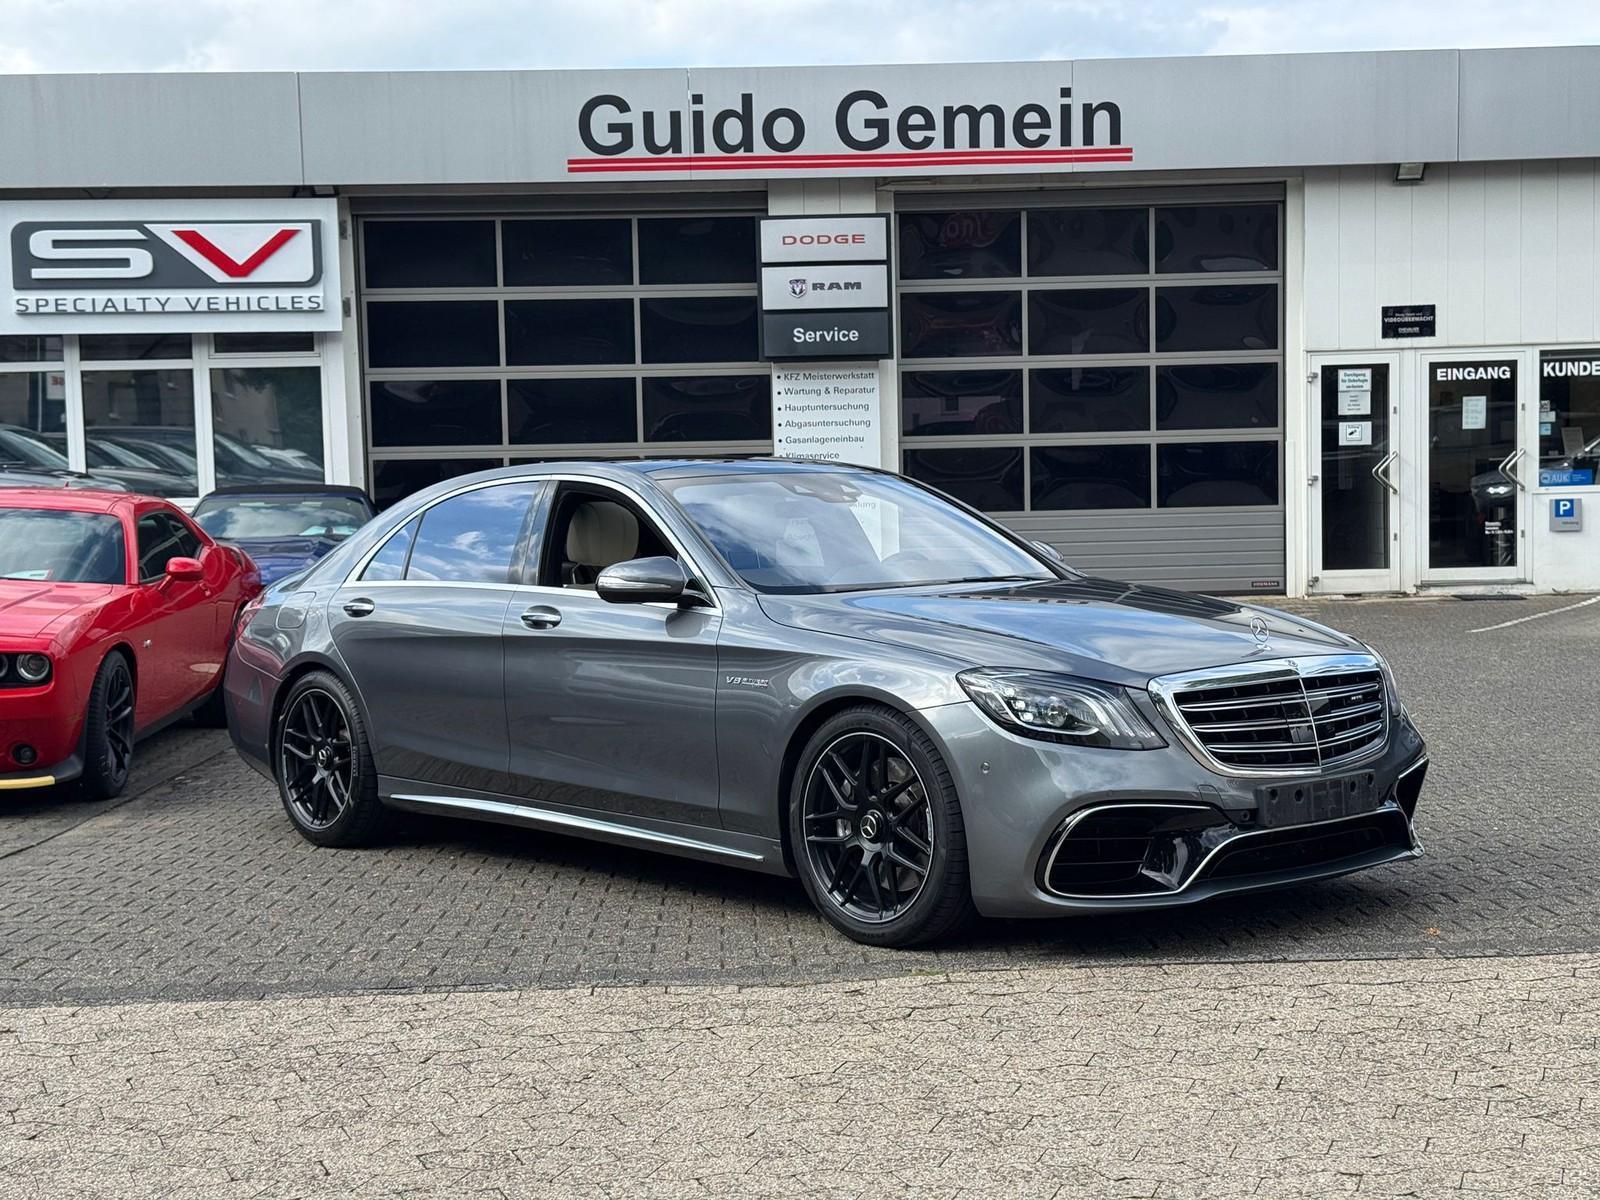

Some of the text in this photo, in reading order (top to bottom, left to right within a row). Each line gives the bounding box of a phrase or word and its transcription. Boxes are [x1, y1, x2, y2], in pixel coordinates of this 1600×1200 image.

[578, 87, 1122, 156] Guido Gemein
[782, 234, 866, 245] DODGE
[29, 228, 302, 279] SV
[812, 281, 862, 291] RAM
[16, 295, 321, 312] SPECIALTY VEHICLES
[793, 327, 859, 342] Service
[783, 372, 875, 381] KFZ Meisterwerkstatt
[1436, 366, 1511, 381] EINGANG
[784, 386, 875, 396] Wartung & Reparatur
[784, 403, 869, 412] Hauptuntersuchung
[785, 419, 871, 429] Abgasuntersuchung
[785, 435, 865, 445] Gasanlageneinbau
[785, 452, 840, 460] Klimaservice
[1560, 501, 1571, 515] P
[726, 676, 741, 684] V8
